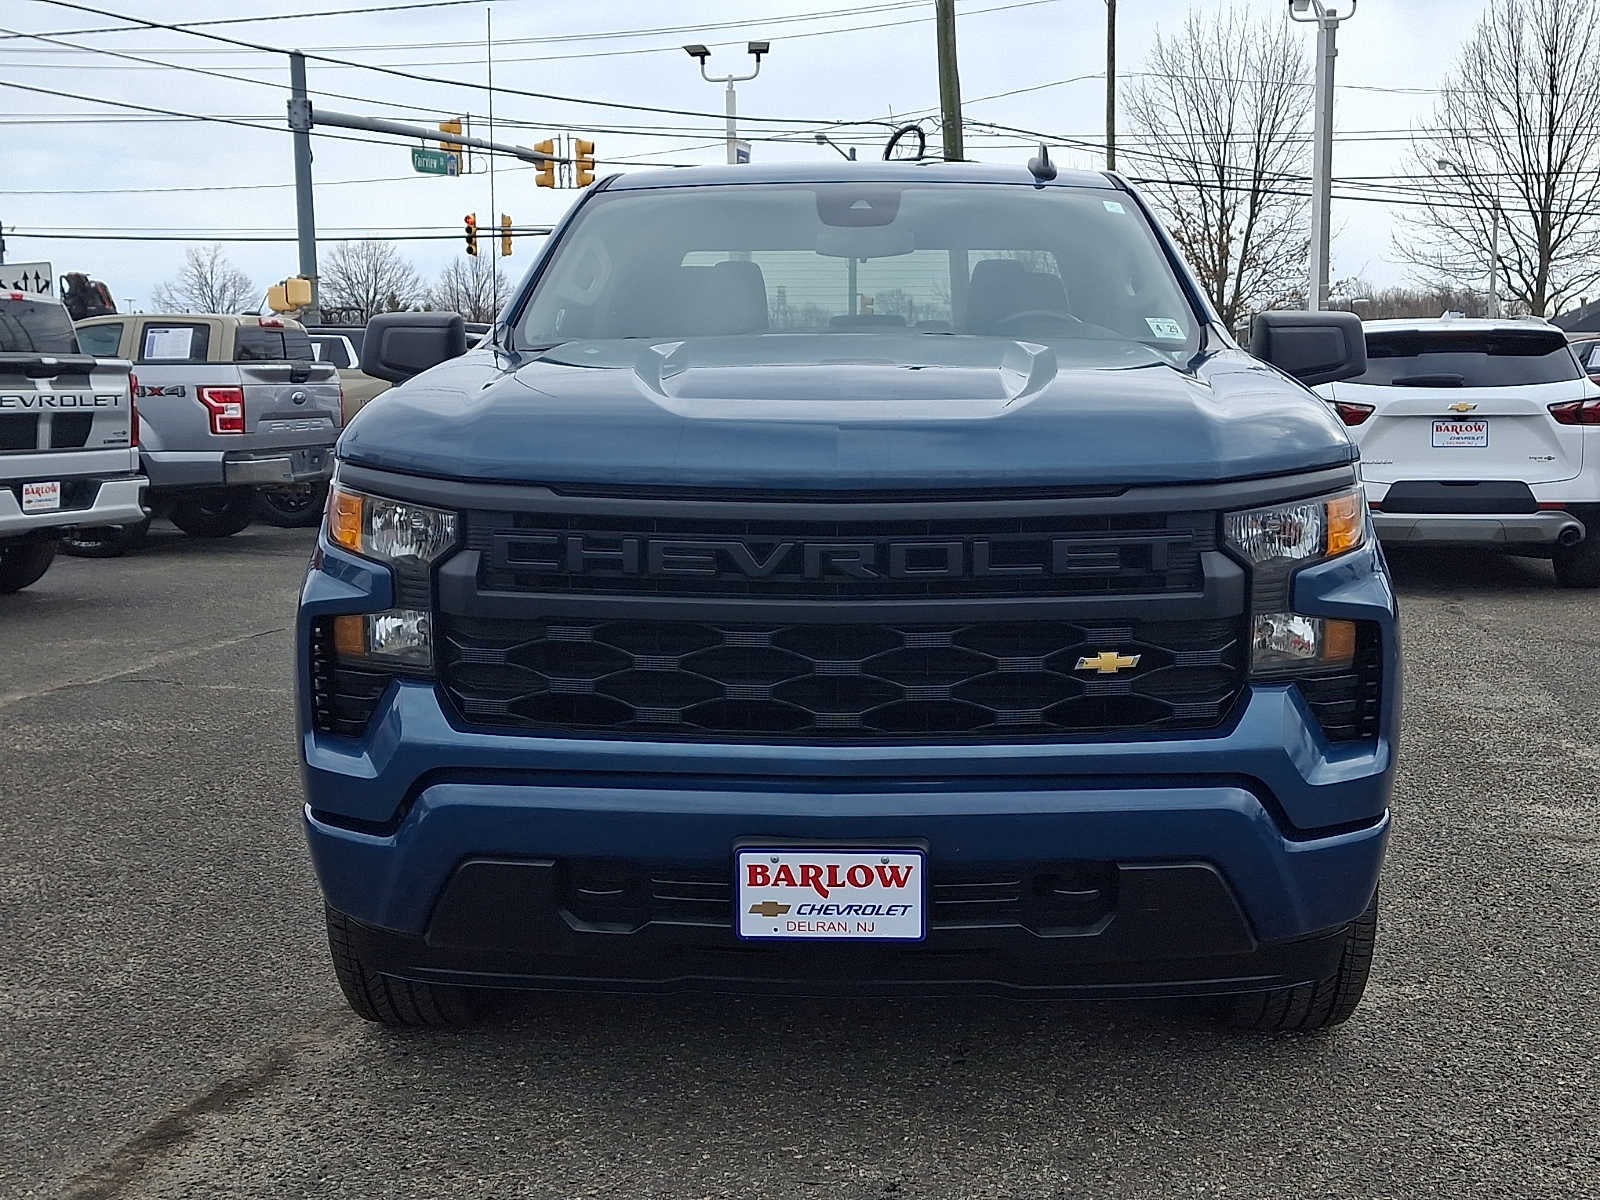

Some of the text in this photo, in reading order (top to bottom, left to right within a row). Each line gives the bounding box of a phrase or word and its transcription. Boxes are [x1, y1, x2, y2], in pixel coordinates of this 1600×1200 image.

[1435, 424, 1485, 435] BARLOW
[25, 486, 58, 497] BARLOW
[492, 530, 1194, 579] CHEVROLET
[746, 864, 914, 899] BARLOW
[796, 903, 913, 916] CHEVROLET
[786, 921, 876, 933] DELRAN, NJ
